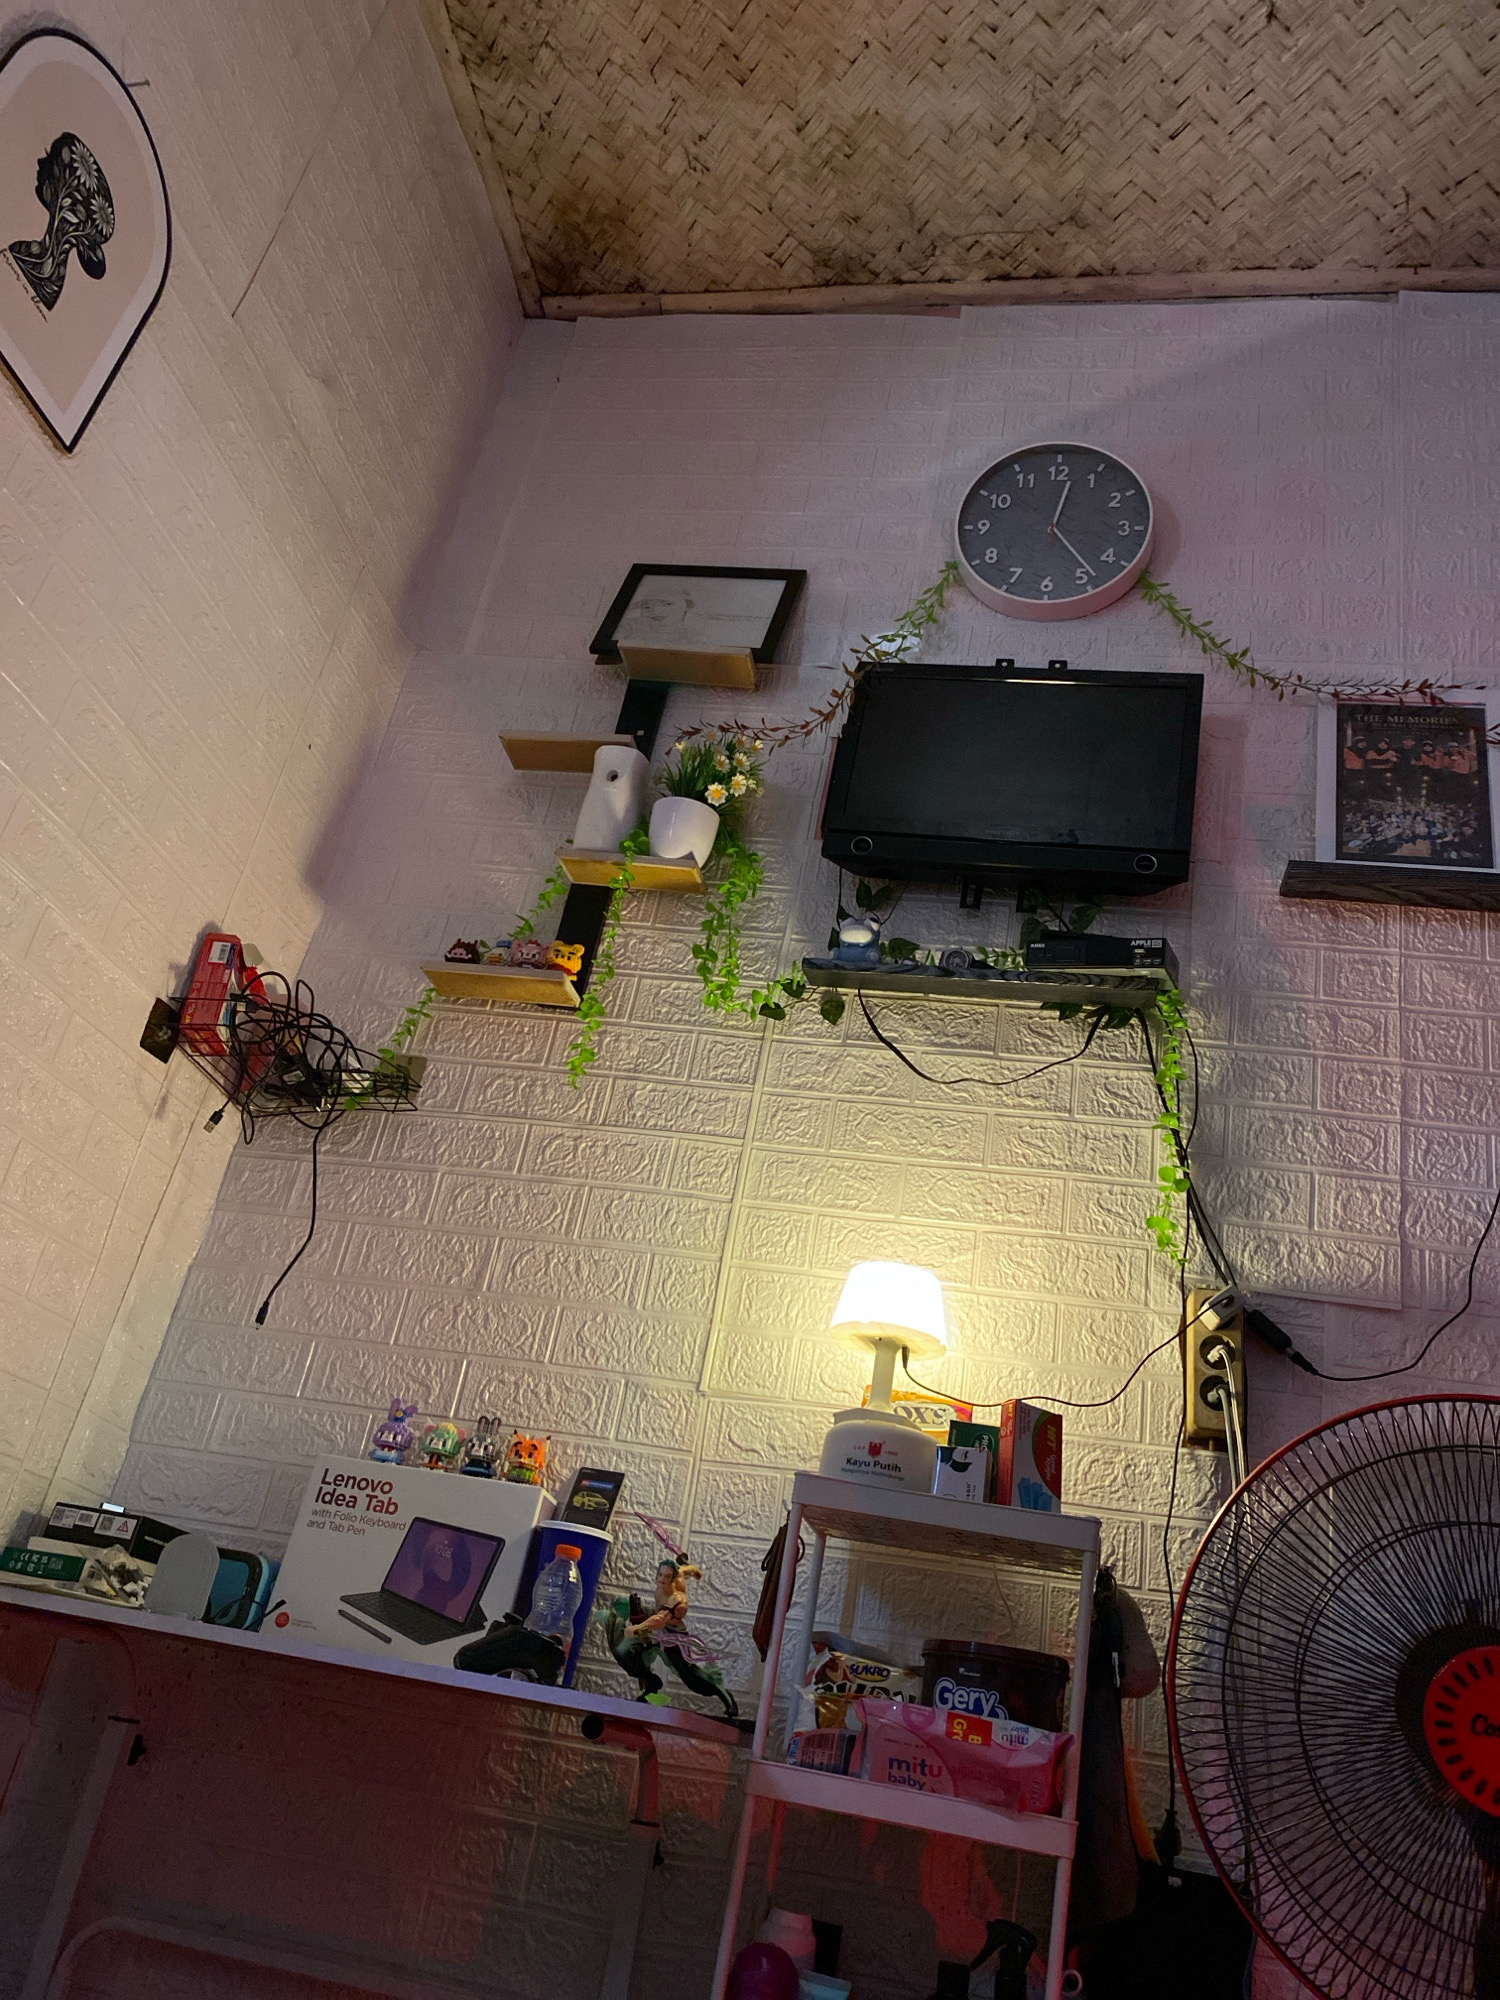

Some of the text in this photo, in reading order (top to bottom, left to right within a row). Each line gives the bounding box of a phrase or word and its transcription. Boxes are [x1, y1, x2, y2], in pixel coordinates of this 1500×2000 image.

[1017, 473, 1035, 488] 11
[1049, 466, 1069, 480] 12
[1087, 473, 1095, 488] 1
[989, 494, 1011, 508] 10
[1108, 492, 1121, 507] 2
[977, 519, 990, 535] 9
[1118, 521, 1130, 535] 3
[985, 548, 998, 563] 8
[1100, 548, 1115, 563] 4
[1009, 567, 1023, 583] 7
[1075, 569, 1088, 584] 5
[1040, 576, 1053, 591] 6
[1355, 713, 1382, 723] THE
[1131, 939, 1151, 947] APPLE
[1047, 1424, 1057, 1452] HIT
[846, 1457, 902, 1473] Kayu Putih
[320, 1467, 394, 1494] Lenovo
[314, 1486, 399, 1516] Idea Tab
[306, 1519, 366, 1537] and Tab Pen
[311, 1507, 407, 1534] with Folio Keyboard
[849, 1663, 891, 1679] SUKRO
[935, 1679, 998, 1718] Gery
[888, 1753, 943, 1780] mitu
[887, 1772, 926, 1791] baby
